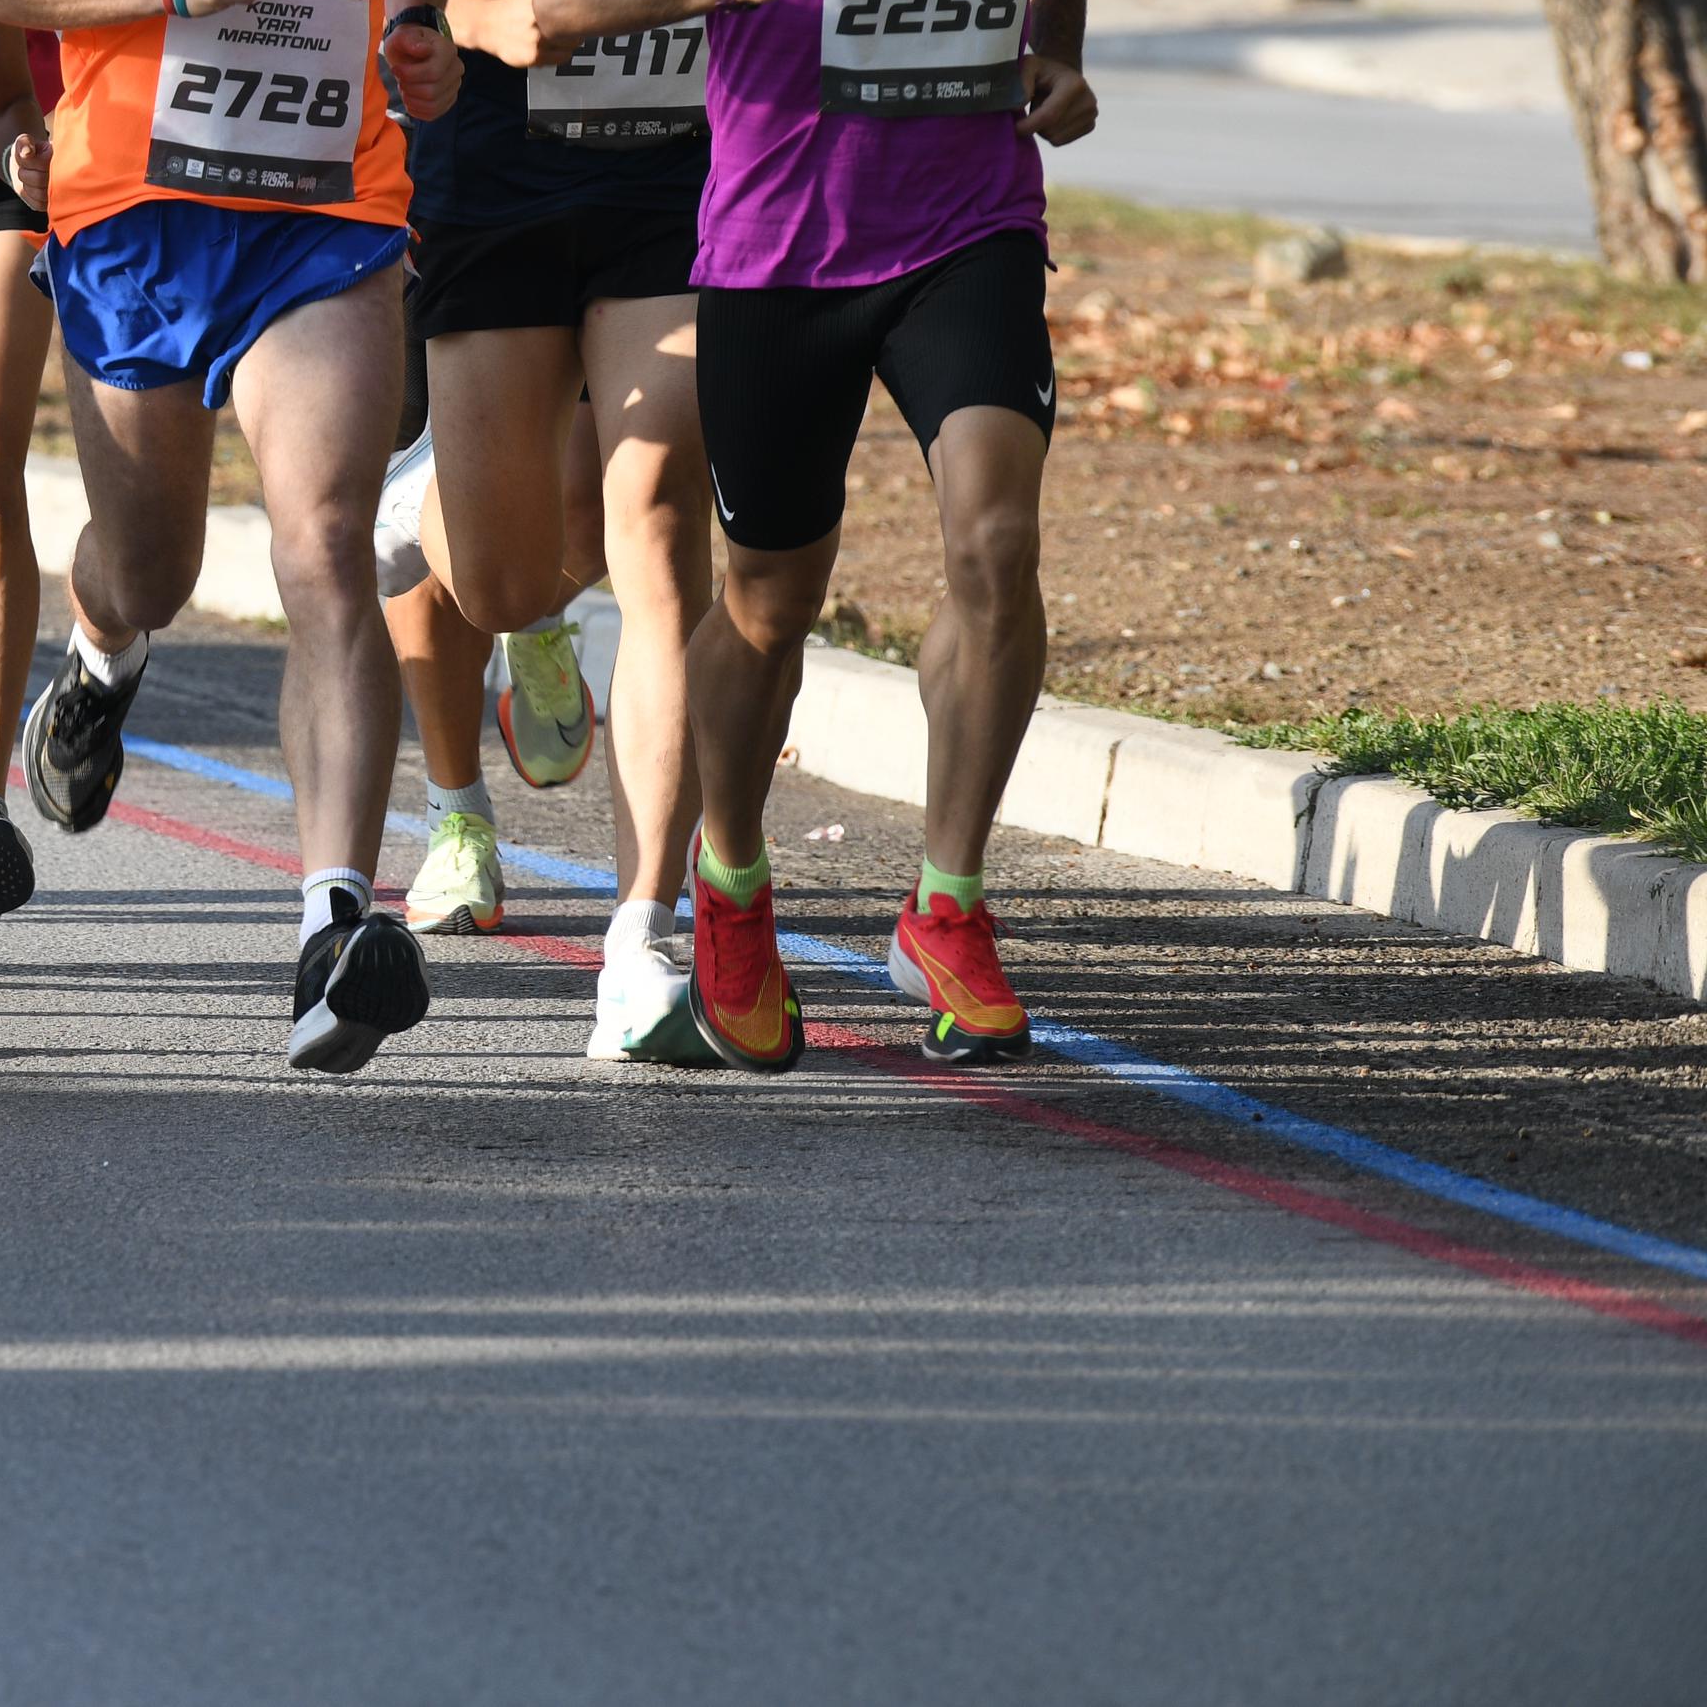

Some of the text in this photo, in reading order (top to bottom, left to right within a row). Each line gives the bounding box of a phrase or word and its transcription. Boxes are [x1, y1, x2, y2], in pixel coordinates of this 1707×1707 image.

[245, 0, 314, 19] KONYA
[257, 16, 301, 34] YARI
[217, 27, 331, 52] MARATONU
[169, 62, 351, 128] 2728
